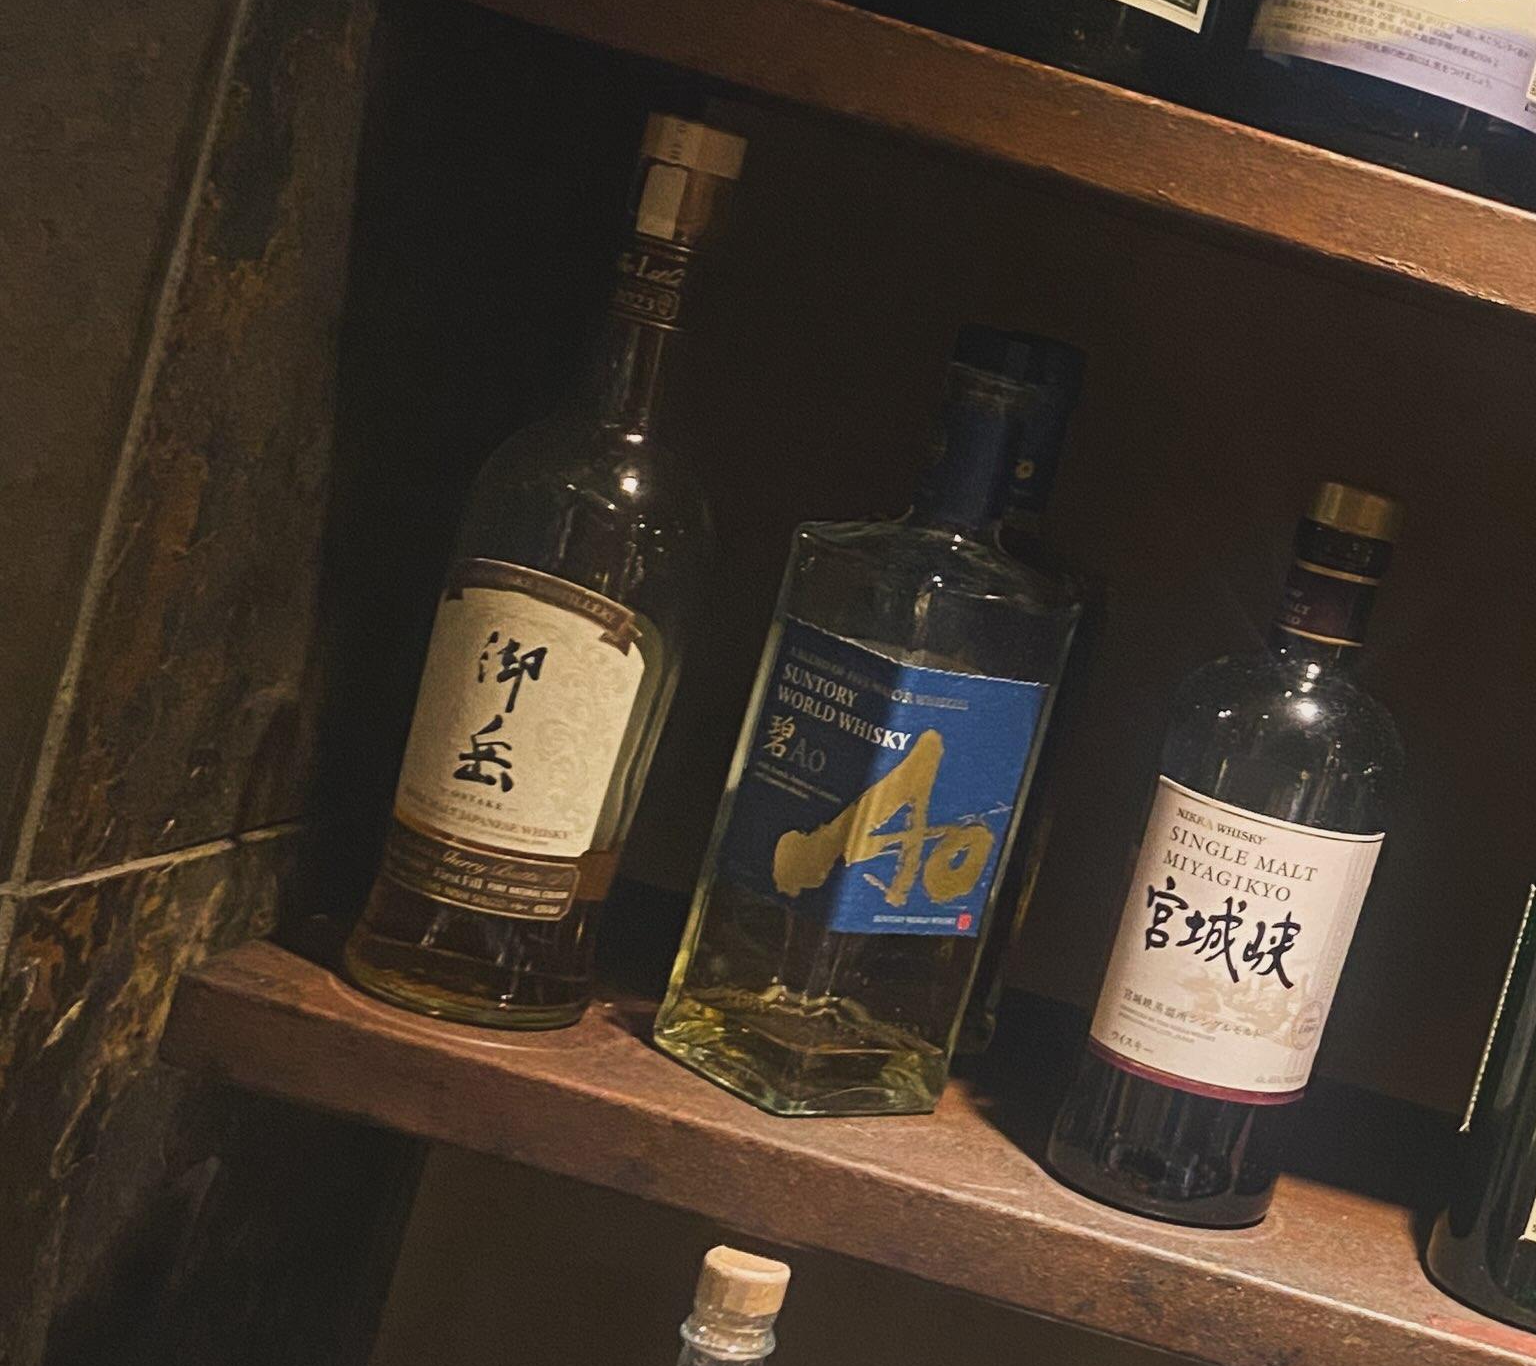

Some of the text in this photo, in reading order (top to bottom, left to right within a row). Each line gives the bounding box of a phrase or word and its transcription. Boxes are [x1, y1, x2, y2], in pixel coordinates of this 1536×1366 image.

[452, 630, 549, 795] 御岳
[782, 661, 860, 709] SUNTORY
[776, 683, 837, 725] WORLD
[838, 712, 912, 752] WHISKY
[1169, 824, 1319, 883] SINGLE MALT
[1215, 822, 1269, 846] WHISKY
[1161, 848, 1292, 903] MIYAGIKYO
[1144, 874, 1302, 990] 宮城峡
